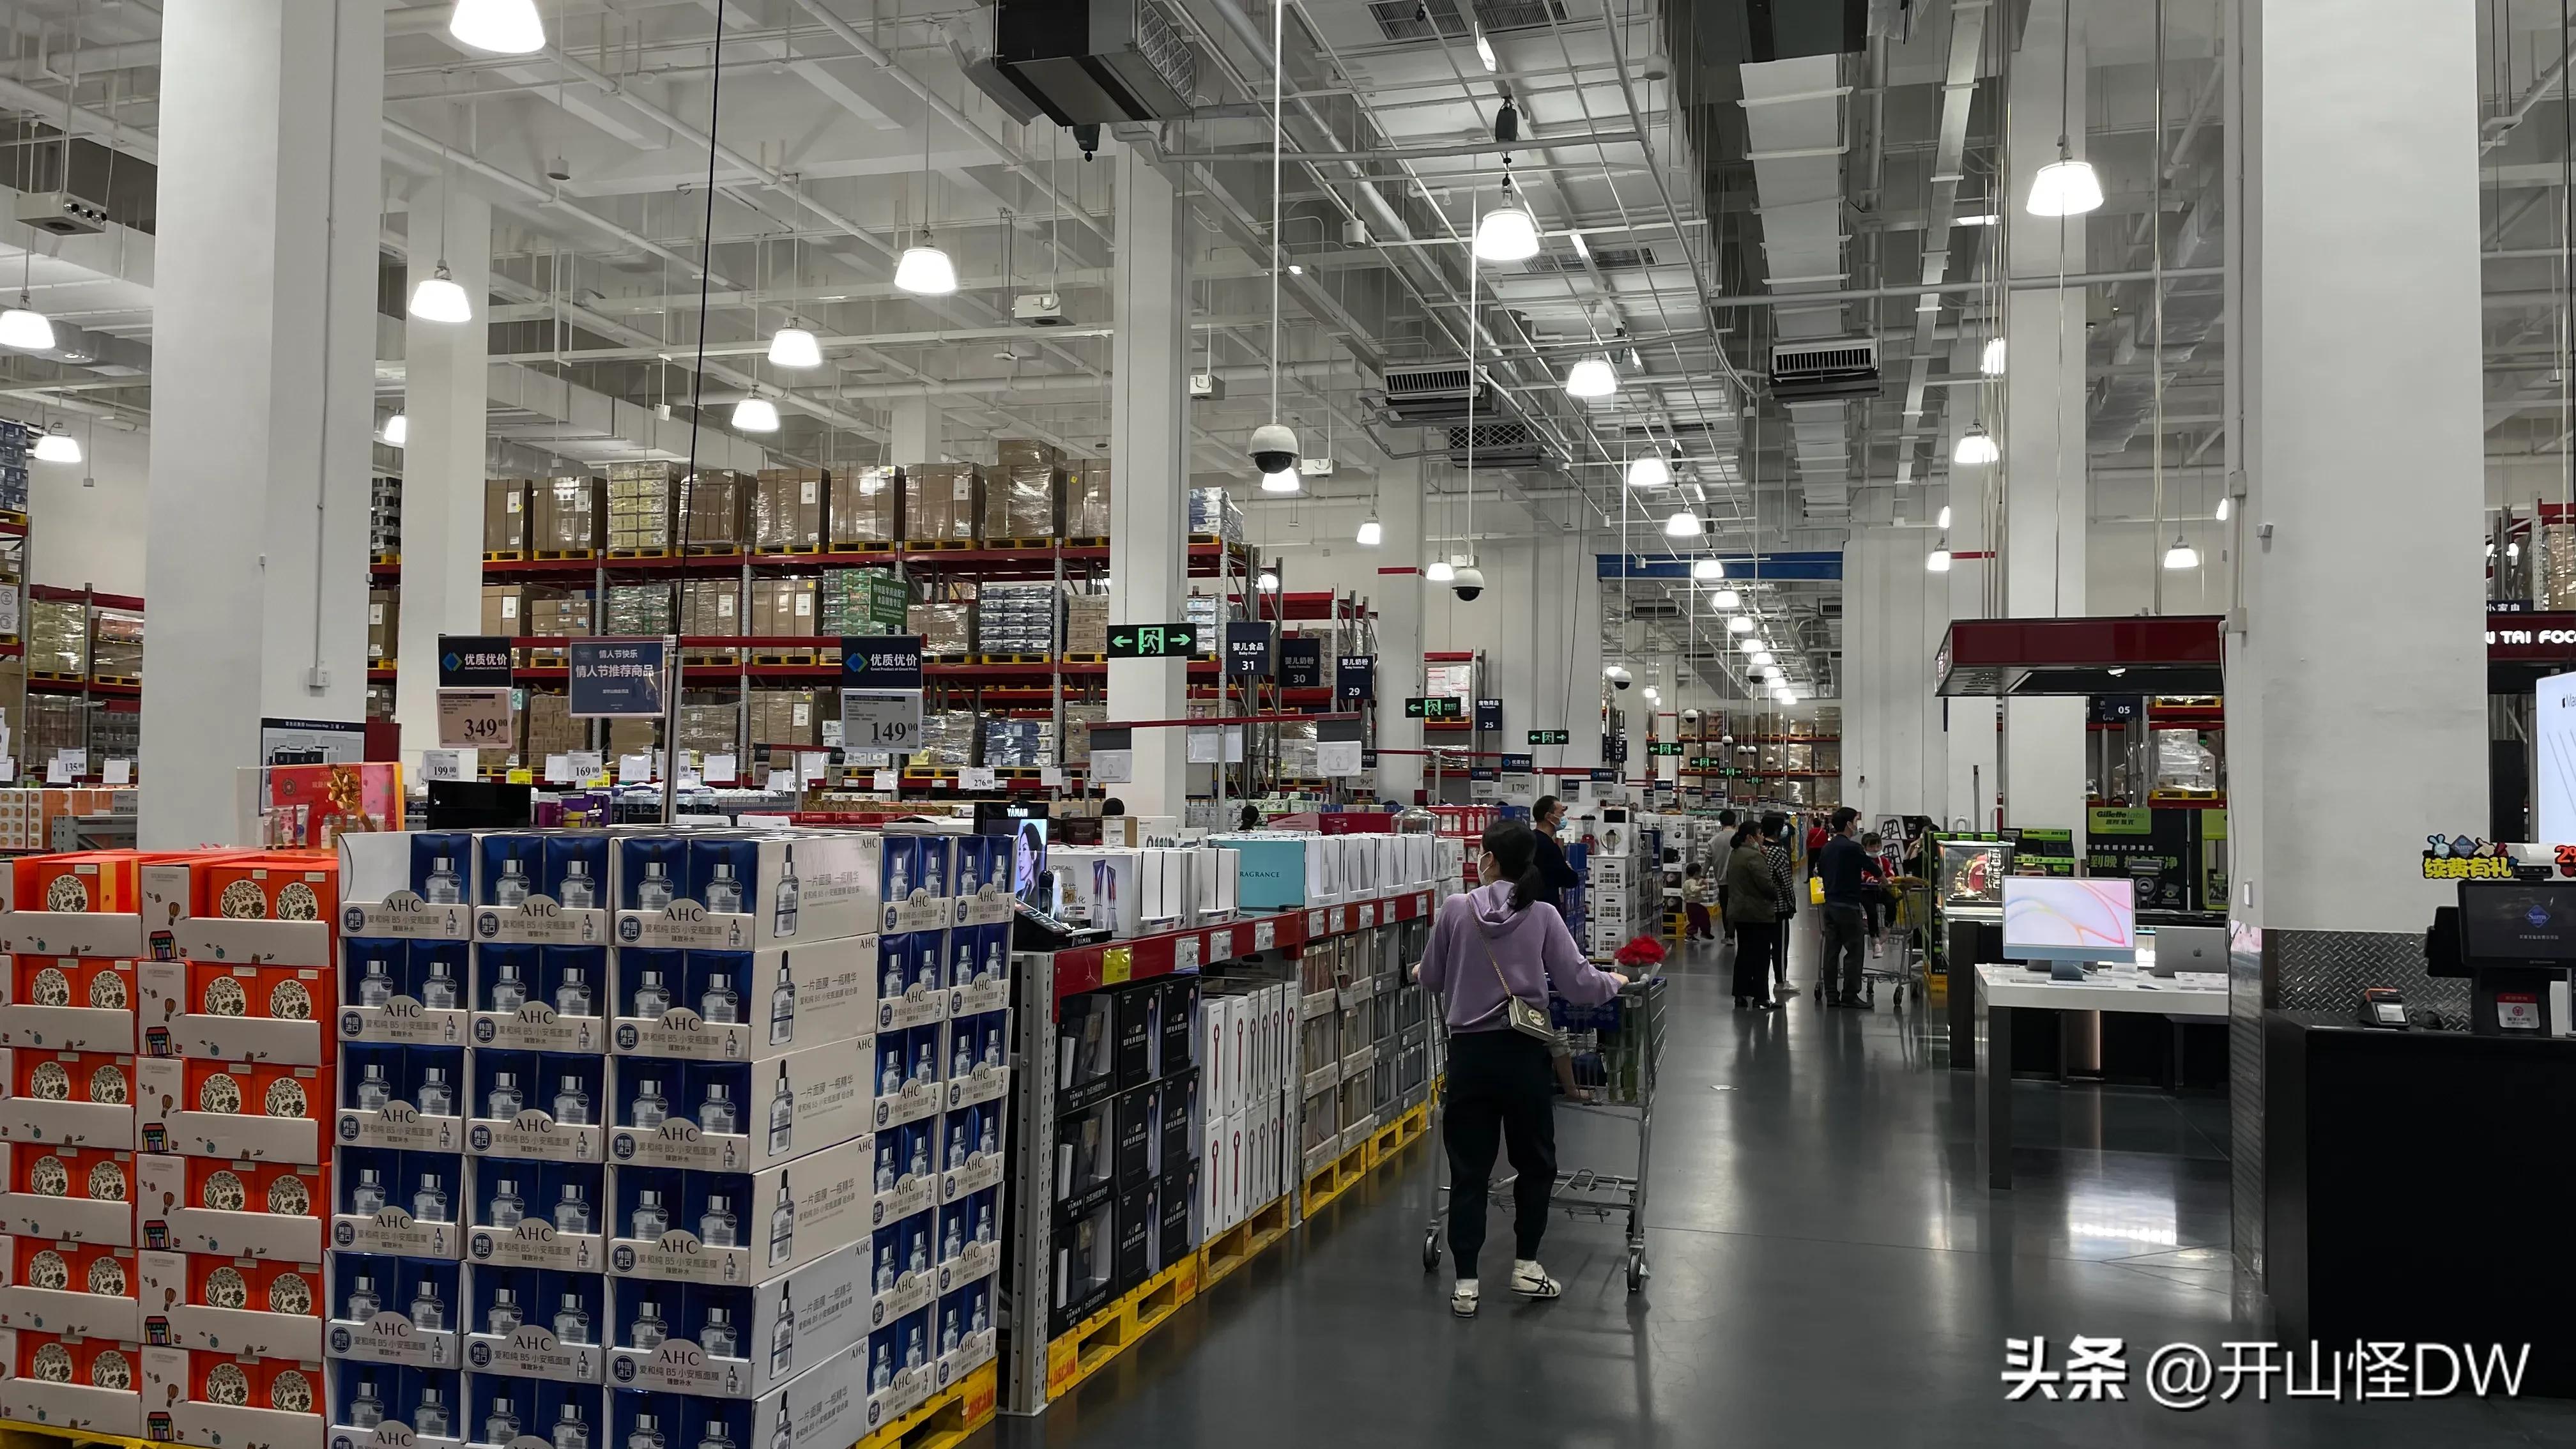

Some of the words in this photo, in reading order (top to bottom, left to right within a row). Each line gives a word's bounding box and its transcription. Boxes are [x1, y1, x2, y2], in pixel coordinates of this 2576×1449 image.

[2500, 631, 2531, 644] TAI
[2539, 630, 2576, 644] FOC
[1232, 642, 1264, 651] 婴儿食品
[464, 653, 507, 666] 优质优价
[599, 649, 638, 659] 情人节快乐
[870, 654, 917, 666] 优质优价
[1285, 657, 1314, 665] 婴儿奶粉
[576, 664, 654, 677] 情人节推荐商品
[1242, 661, 1254, 670] 31
[1293, 674, 1306, 683] 30
[1349, 687, 1360, 696] 29
[862, 838, 877, 848] AHC
[2424, 857, 2512, 878] 续费有礼
[910, 896, 928, 907] AHC
[979, 891, 995, 901] AHC
[386, 899, 421, 912] AHC
[521, 904, 556, 917] AHC
[664, 908, 702, 922] AHC
[860, 938, 876, 949] AHC
[974, 979, 990, 991] AHC
[905, 990, 924, 1003] AHC
[384, 1004, 420, 1018] AHC
[518, 1010, 553, 1024] AHC
[661, 1016, 700, 1031] AHC
[857, 1038, 872, 1050] AHC
[971, 1068, 988, 1081] AHC
[901, 1085, 920, 1099] AHC
[381, 1109, 415, 1123] AHC
[514, 1118, 551, 1133] AHC
[659, 1127, 696, 1142] AHC
[858, 1139, 873, 1153] AHC
[966, 1156, 984, 1172] AHC
[896, 1179, 916, 1197] AHC
[376, 1215, 410, 1229] AHC
[516, 1227, 552, 1241] AHC
[659, 1239, 697, 1254] AHC
[855, 1241, 870, 1256] AHC
[962, 1246, 979, 1262] AHC
[896, 1276, 915, 1294] AHC
[372, 1322, 408, 1337] AHC
[514, 1335, 551, 1351] AHC
[960, 1337, 976, 1354] AHC
[659, 1349, 699, 1366] AHC
[851, 1342, 866, 1360] AHC
[891, 1374, 912, 1392] AHC
[376, 1431, 411, 1446] AHC
